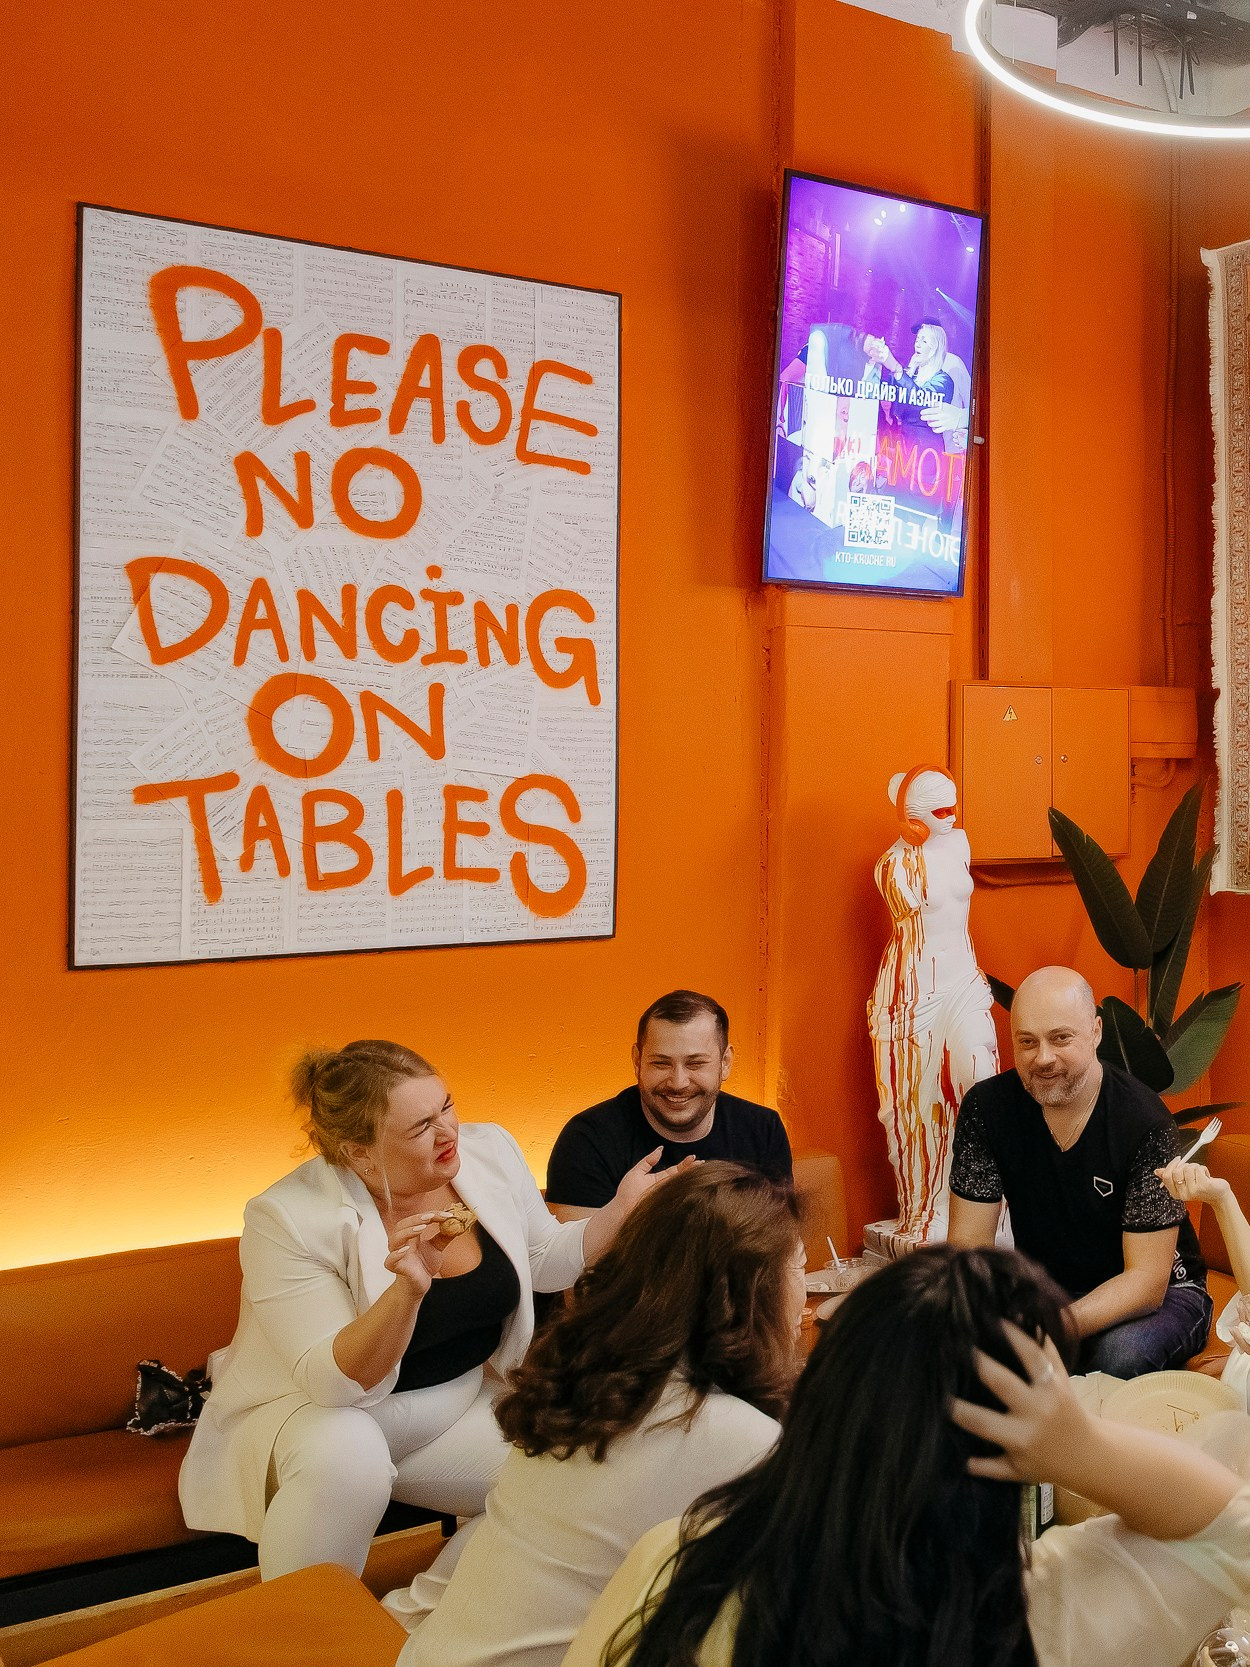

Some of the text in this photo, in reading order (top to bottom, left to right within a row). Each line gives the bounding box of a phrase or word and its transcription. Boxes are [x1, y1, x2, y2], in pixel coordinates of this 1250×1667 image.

[148, 265, 599, 476] PLEASE
[806, 373, 853, 397] ТОЛЬКО
[855, 381, 899, 403] ДРАЙВ
[898, 386, 907, 404] И
[908, 388, 946, 409] АЗАРТ
[233, 447, 422, 540] NO
[245, 672, 446, 779] ON
[132, 771, 587, 919] TABLES
